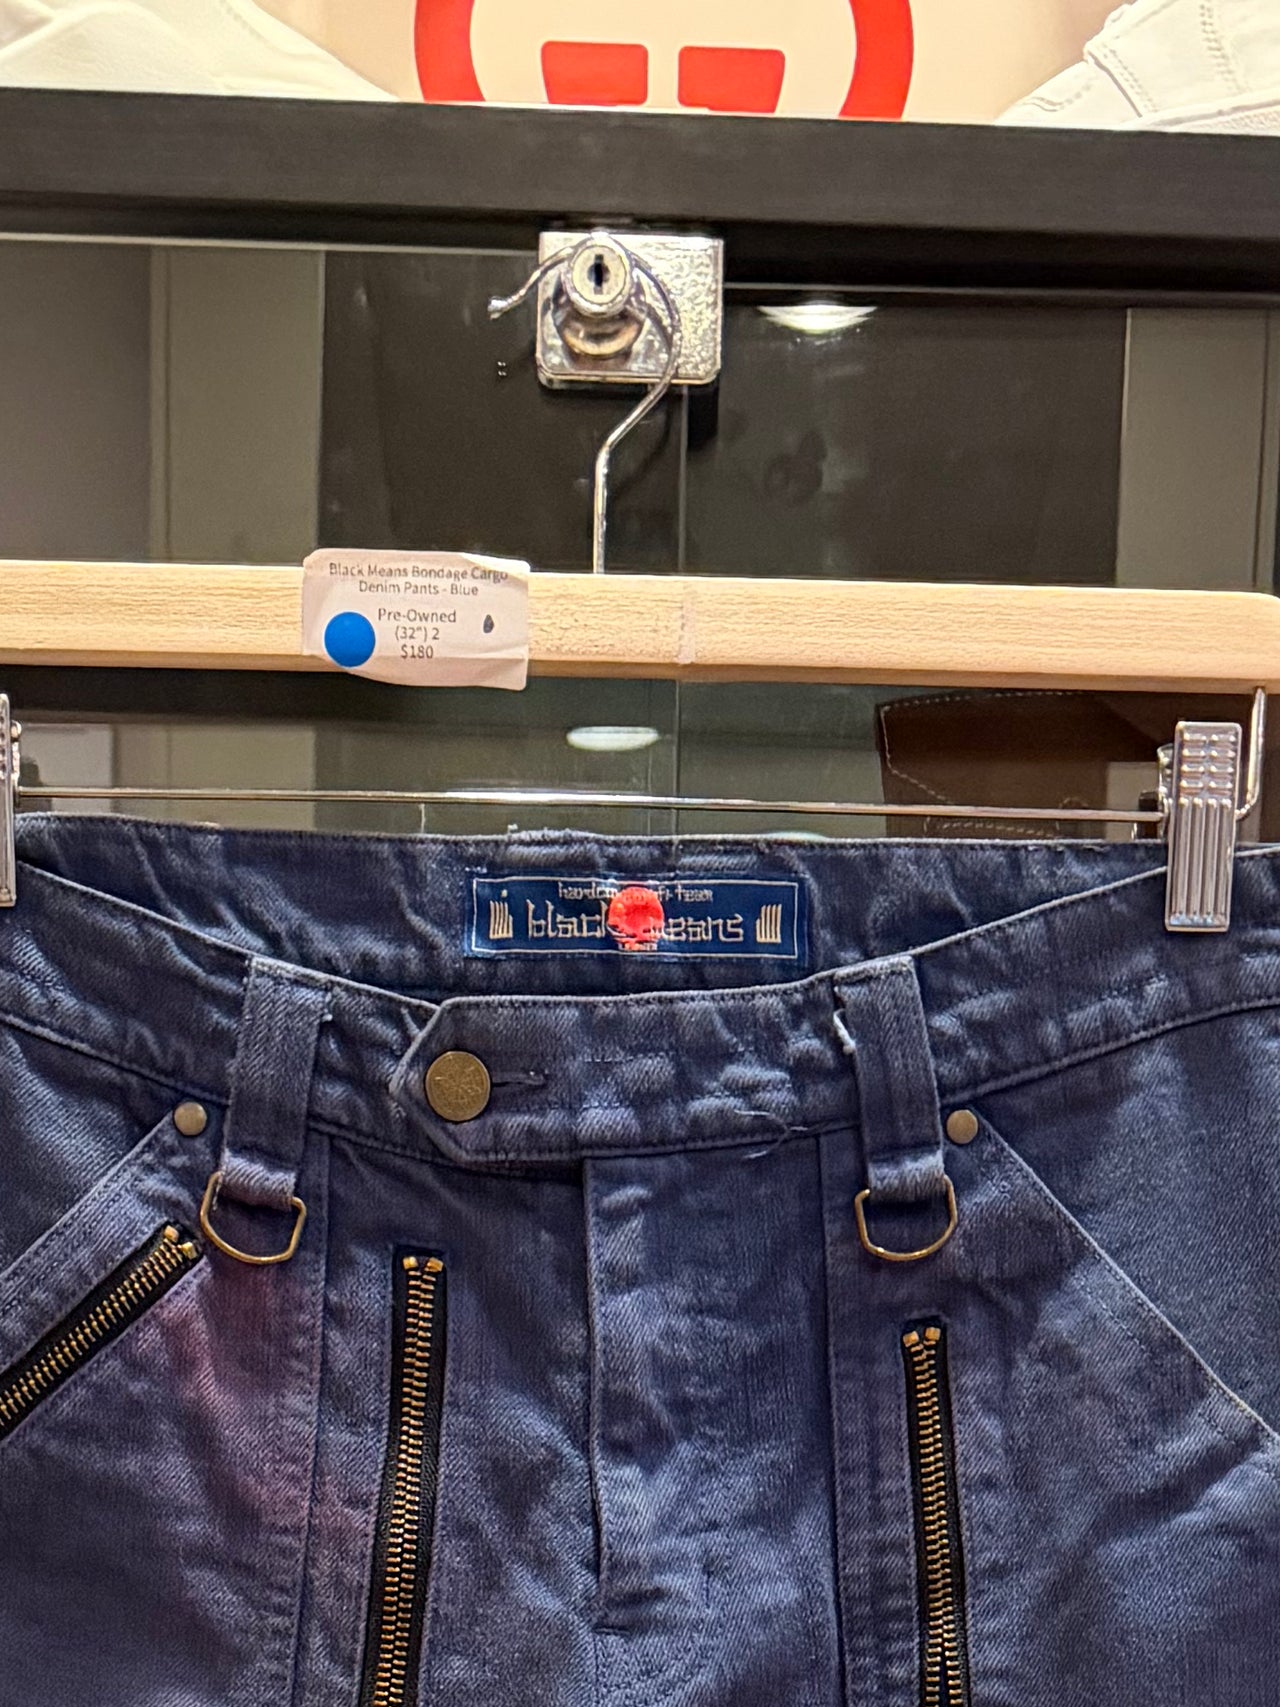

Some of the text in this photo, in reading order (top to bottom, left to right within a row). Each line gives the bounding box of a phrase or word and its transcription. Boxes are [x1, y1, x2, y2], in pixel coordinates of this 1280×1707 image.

[329, 562, 509, 583] Black Means Bondage Cargo
[359, 580, 401, 595] Denim
[404, 581, 439, 596] Pants
[450, 583, 479, 596] Blue
[378, 608, 456, 623] Pre-Owned
[431, 627, 440, 640] 2
[400, 645, 434, 660] $180
